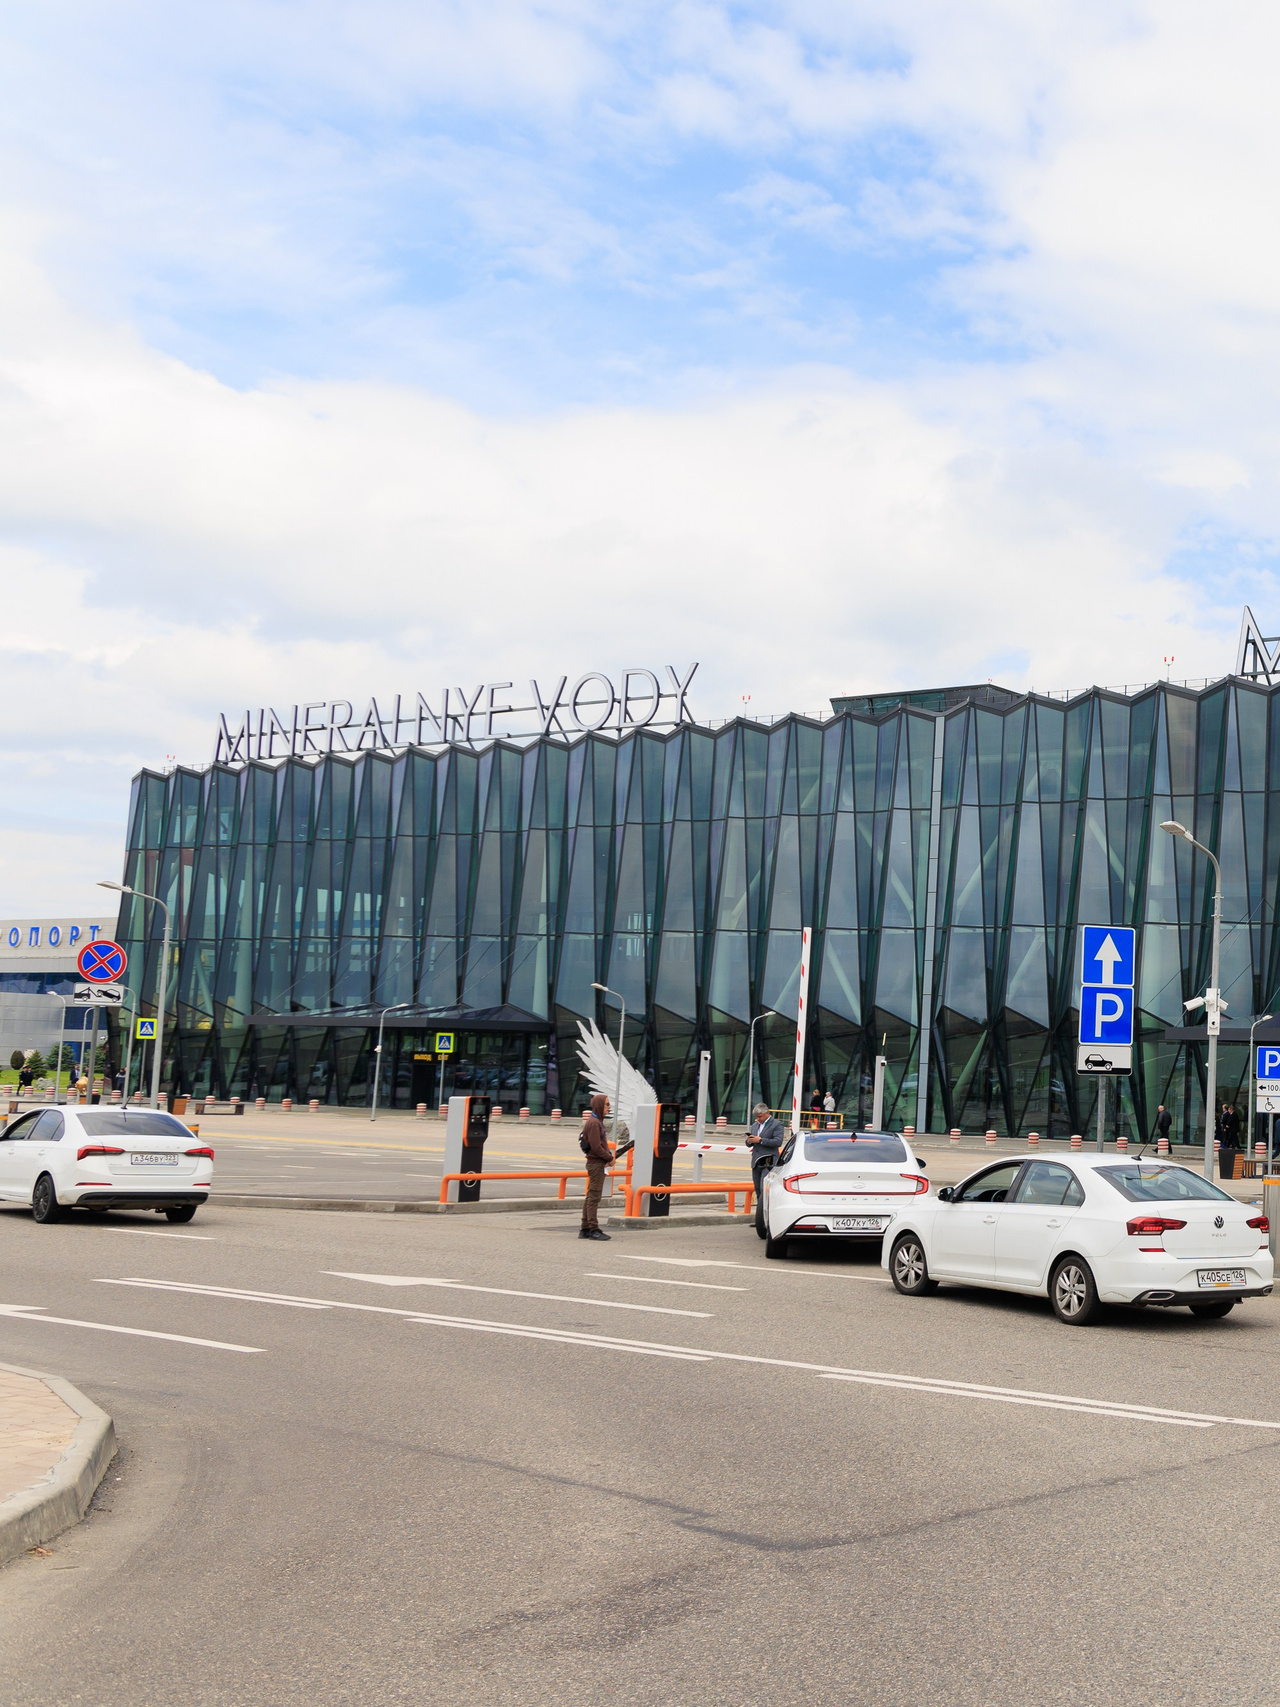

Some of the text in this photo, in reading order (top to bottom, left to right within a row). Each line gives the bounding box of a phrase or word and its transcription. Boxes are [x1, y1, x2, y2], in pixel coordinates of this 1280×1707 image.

[213, 661, 700, 763] MINERALNYE VODY
[1094, 992, 1125, 1038] P
